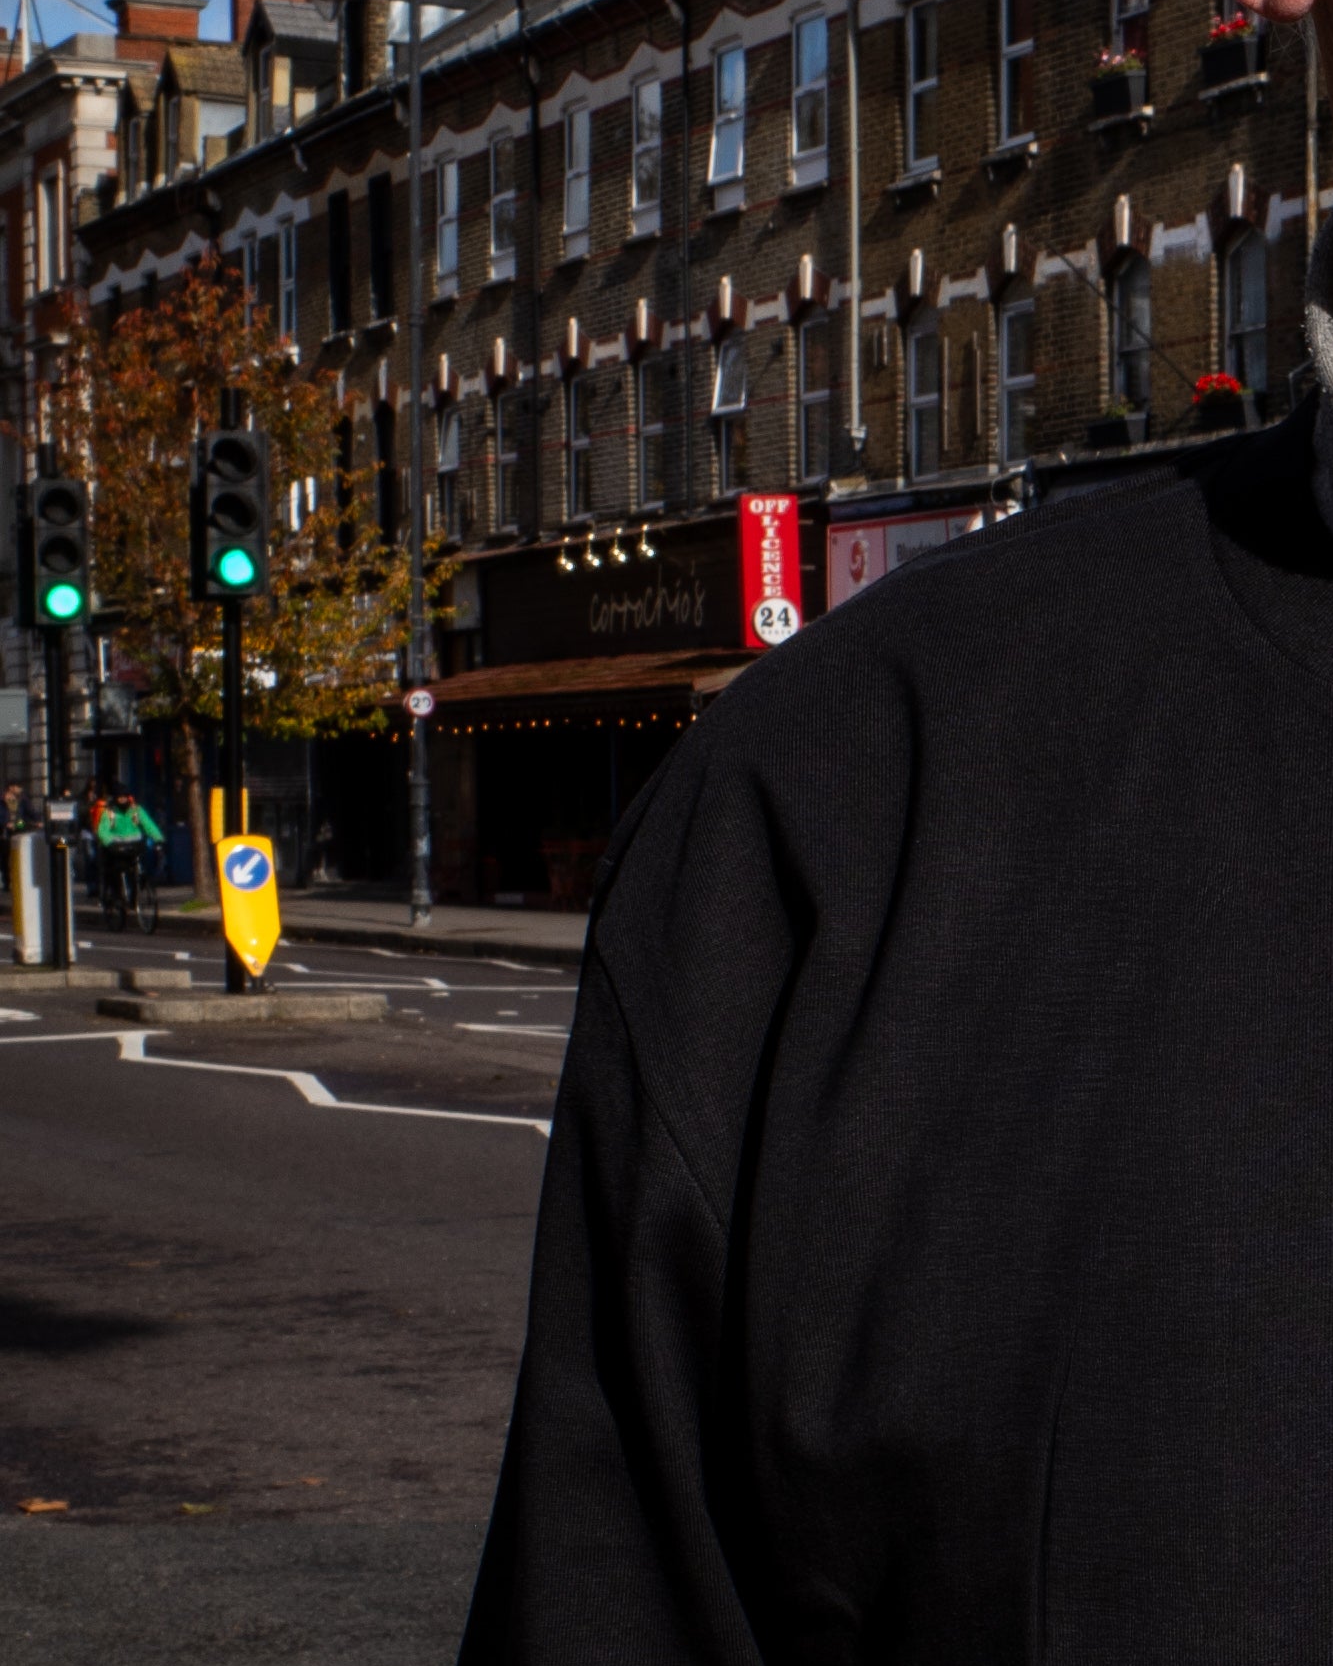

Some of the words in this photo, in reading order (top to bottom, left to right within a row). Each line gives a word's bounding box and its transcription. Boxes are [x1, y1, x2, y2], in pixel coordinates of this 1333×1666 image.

[749, 498, 791, 514] OFF
[760, 514, 783, 597] LICENCE
[760, 607, 791, 627] 24
